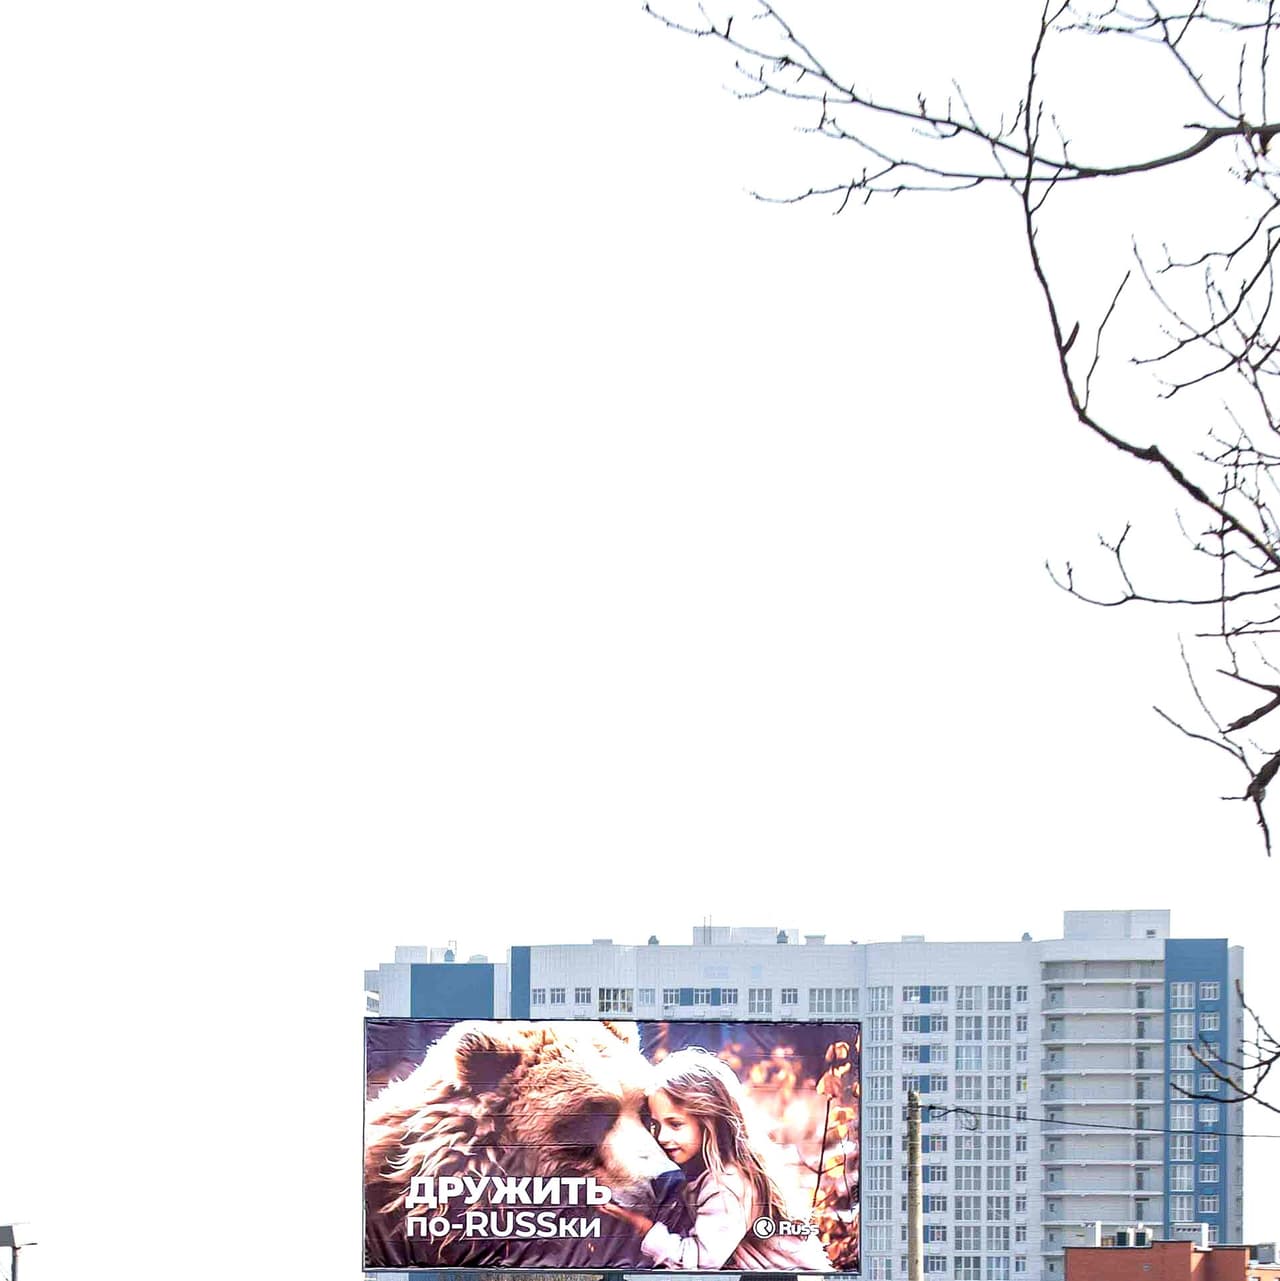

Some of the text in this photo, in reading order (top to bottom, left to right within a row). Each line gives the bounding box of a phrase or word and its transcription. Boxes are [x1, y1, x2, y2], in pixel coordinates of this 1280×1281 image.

[405, 1176, 612, 1208] ДРУЖИТЬ
[407, 1211, 601, 1238] по-RUSSки
[779, 1220, 820, 1235] Russ
